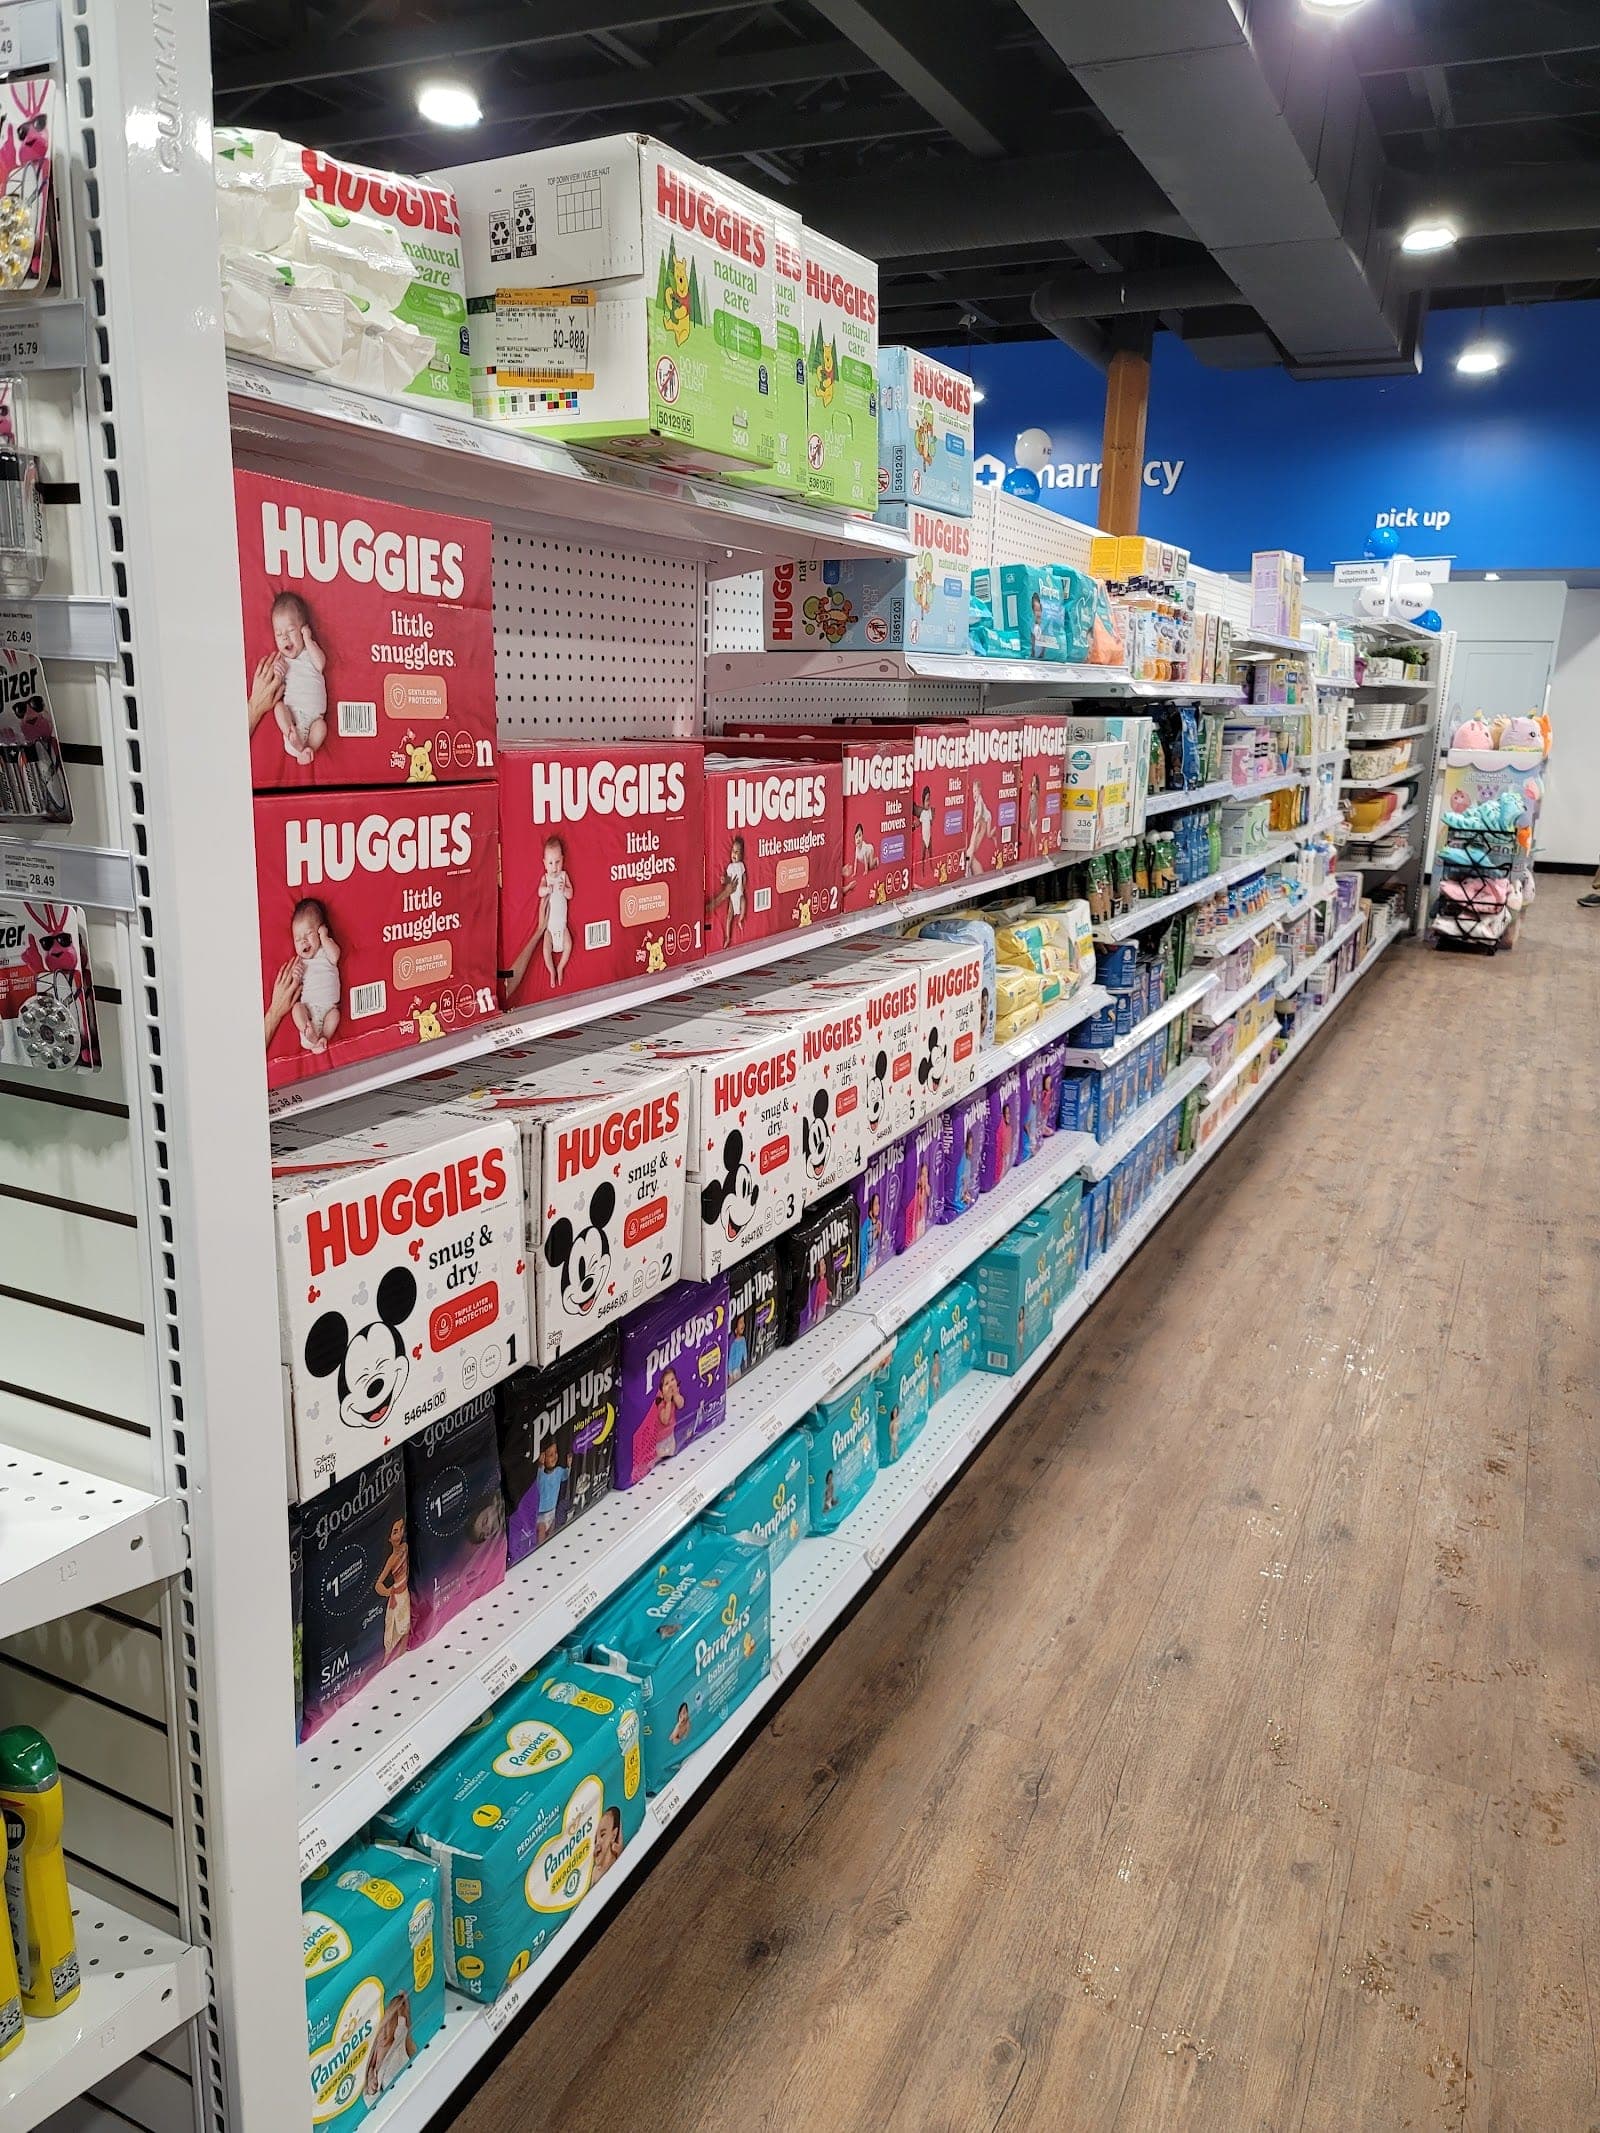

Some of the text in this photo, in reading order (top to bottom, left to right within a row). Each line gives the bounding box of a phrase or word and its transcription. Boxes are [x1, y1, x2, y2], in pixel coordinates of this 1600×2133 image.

[656, 163, 766, 270] HUGGIES
[713, 258, 758, 295] natural
[723, 288, 751, 313] care
[806, 259, 876, 326] HUGGIES
[842, 320, 871, 344] natural
[13, 342, 38, 355] 15.79
[848, 339, 865, 357] care
[913, 362, 972, 416] HUGGIES
[1376, 507, 1451, 531] pick up
[914, 512, 970, 556] HUGGIES
[261, 501, 465, 600] HUGGIES
[1338, 575, 1378, 585] supplements
[1341, 568, 1369, 576] vitamins
[1415, 569, 1432, 577] baby
[6, 630, 32, 643] 26.49
[390, 610, 434, 638] little
[370, 643, 453, 671] snugglers
[407, 696, 442, 705] PROTECTION
[438, 739, 447, 750] 76
[476, 739, 494, 767] n
[843, 754, 913, 797] HUGGIES
[948, 777, 962, 792] little
[1002, 770, 1015, 784] little
[1049, 765, 1060, 777] little
[532, 761, 685, 825] HUGGIES
[726, 775, 826, 830] HUGGIES
[944, 793, 964, 807] movers
[998, 786, 1017, 800] movers
[885, 800, 902, 815] little
[880, 816, 906, 833] movers
[1076, 819, 1092, 827] 336
[285, 811, 472, 887] HUGGIES
[626, 830, 660, 854] little
[757, 830, 826, 859] little snugglers
[610, 854, 676, 882] snugglers
[959, 851, 966, 871] 4
[30, 873, 55, 887] 28.49
[901, 868, 909, 890] 3
[402, 885, 442, 913] little
[829, 886, 838, 910] 2
[382, 910, 460, 943] snugglers
[693, 920, 702, 949] 1
[415, 959, 448, 973] PROTECTION
[926, 960, 980, 1010] HUGGIES
[442, 998, 450, 1007] 76
[476, 986, 496, 1014] n
[802, 1013, 863, 1066] HUGGIES
[893, 1026, 906, 1041] snug
[897, 1037, 907, 1053] dry
[836, 1059, 850, 1074] snug
[841, 1069, 853, 1086] dry
[969, 1063, 975, 1083] 6
[714, 1047, 797, 1116] HUGGIES
[760, 1097, 789, 1123] snug &
[909, 1100, 916, 1119] 5
[557, 1091, 680, 1183] HUGGIES
[767, 1119, 781, 1138] dry
[627, 1151, 669, 1184] snug &
[854, 1145, 861, 1167] 4
[636, 1179, 657, 1201] dry
[306, 1147, 507, 1277] HUGGIES
[786, 1193, 795, 1219] 3
[428, 1223, 493, 1271] snug &
[809, 1218, 849, 1278] Pull-Ups
[446, 1260, 478, 1290] dry
[660, 1252, 673, 1282] 2
[454, 1297, 489, 1319] TRIPLE LAYER
[454, 1303, 494, 1328] PROTECTION
[728, 1271, 774, 1336] Pull-Ups
[940, 1316, 968, 1350] Pampers
[506, 1333, 517, 1366] 1
[645, 1311, 714, 1395] Pull-Ups
[900, 1355, 929, 1400] Pampers
[532, 1363, 613, 1463] Pull-Ups
[832, 1406, 870, 1461] Pampers
[314, 1461, 337, 1479] baby
[317, 1456, 403, 1551] goodnites
[434, 1577, 441, 1593] L
[646, 1576, 696, 1618] Pampers
[694, 1605, 751, 1677] Pampers
[321, 1651, 349, 1684] S/M
[500, 1662, 519, 1680] 17.49
[707, 1644, 740, 1683] baby-dry
[509, 1729, 550, 1767] Pampers
[528, 1737, 557, 1766] swaddlers
[400, 1753, 420, 1773] 17.79
[409, 1779, 427, 1794] 32
[493, 1816, 510, 1832] 32
[516, 1805, 560, 1855] PEDIATRICIAN
[304, 1838, 328, 1861] 17.79
[544, 1816, 593, 1882] Pampers
[550, 1842, 591, 1894] swaddlers
[465, 1914, 478, 1950] Pampers
[469, 1979, 481, 1994] 32
[503, 1993, 519, 2011] 15.99
[310, 2018, 373, 2094] Pampers
[318, 2042, 368, 2103] swaddlers
